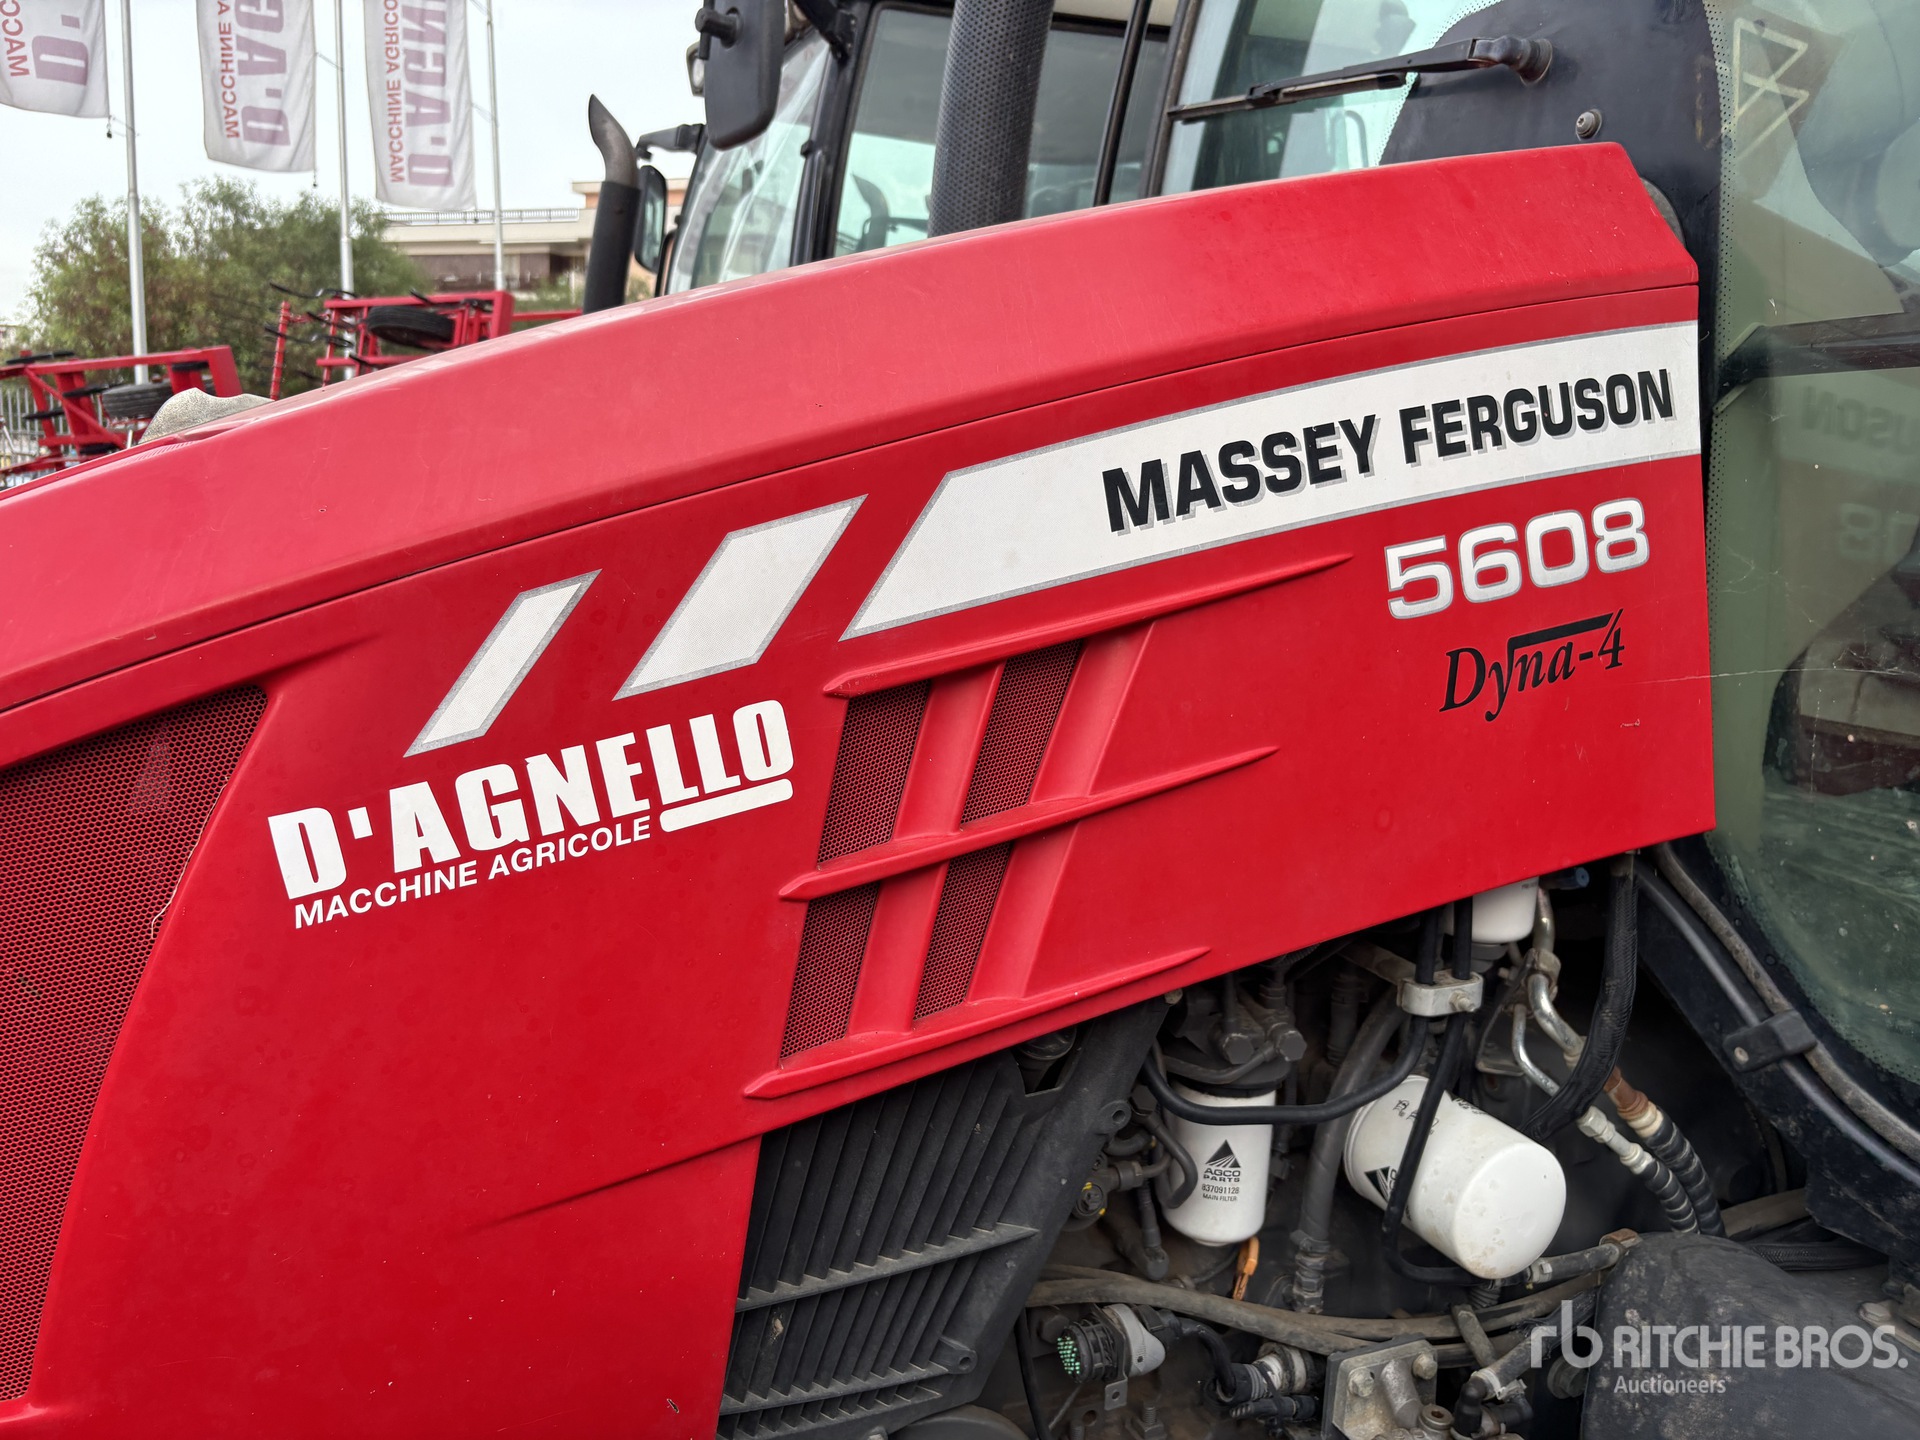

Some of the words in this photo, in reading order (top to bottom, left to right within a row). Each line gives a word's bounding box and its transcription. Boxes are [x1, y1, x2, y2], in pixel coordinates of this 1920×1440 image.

[1102, 414, 1379, 535] MASSEY
[1398, 368, 1675, 466] FERGUSON
[1384, 498, 1650, 620] 5608
[1438, 609, 1625, 722] Dyna-4
[267, 700, 795, 900] D'AGNELLO
[294, 860, 478, 929] MACCHINE
[488, 817, 652, 880] AGRICOLE
[1201, 1183, 1240, 1195] 837091128
[1202, 1192, 1219, 1201] MAIN
[1203, 1167, 1241, 1177] AGCO
[1203, 1174, 1240, 1182] PARTS
